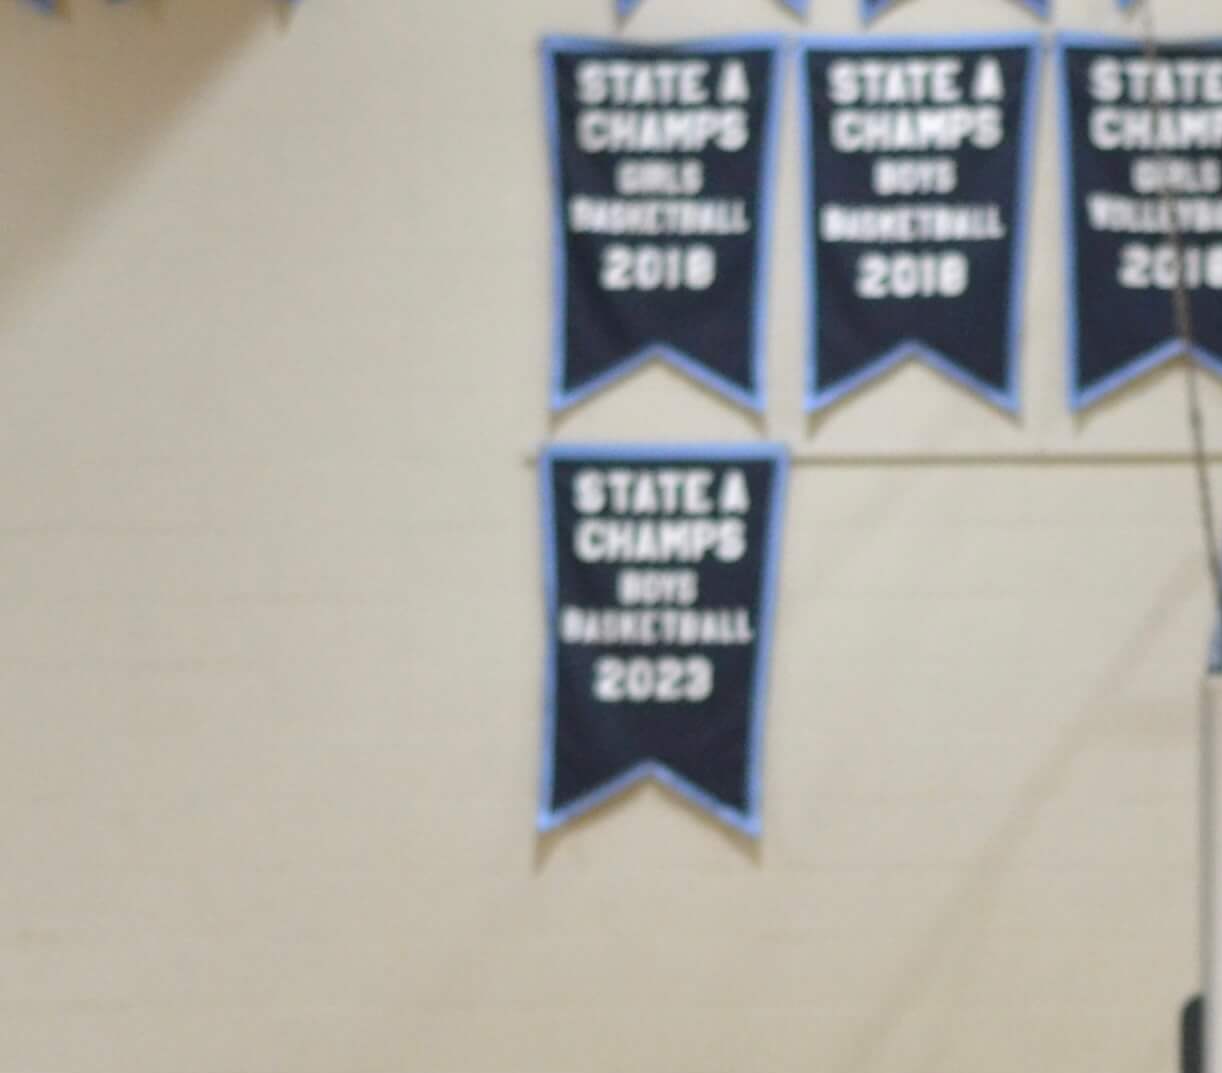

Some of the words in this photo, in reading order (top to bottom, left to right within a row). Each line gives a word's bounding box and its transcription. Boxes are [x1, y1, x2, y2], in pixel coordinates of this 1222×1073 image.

[576, 60, 709, 104] STATE
[718, 61, 749, 103] A
[828, 58, 961, 103] STATE
[972, 59, 1004, 102] A
[578, 106, 748, 152] CHAMPS
[831, 105, 1003, 152] CHAMPS
[616, 159, 703, 197] GIRLS
[873, 157, 957, 196] BOYS
[1131, 156, 1222, 196] GIRLS
[569, 196, 748, 235] BASKETBALL
[821, 205, 1004, 242] BASKETBALL
[574, 469, 713, 516] STATE
[719, 471, 749, 513] A
[575, 516, 746, 562] CHAMPS
[617, 569, 698, 607] BOYS
[559, 607, 753, 645] BASKETBALL
[593, 656, 713, 702] 2023
